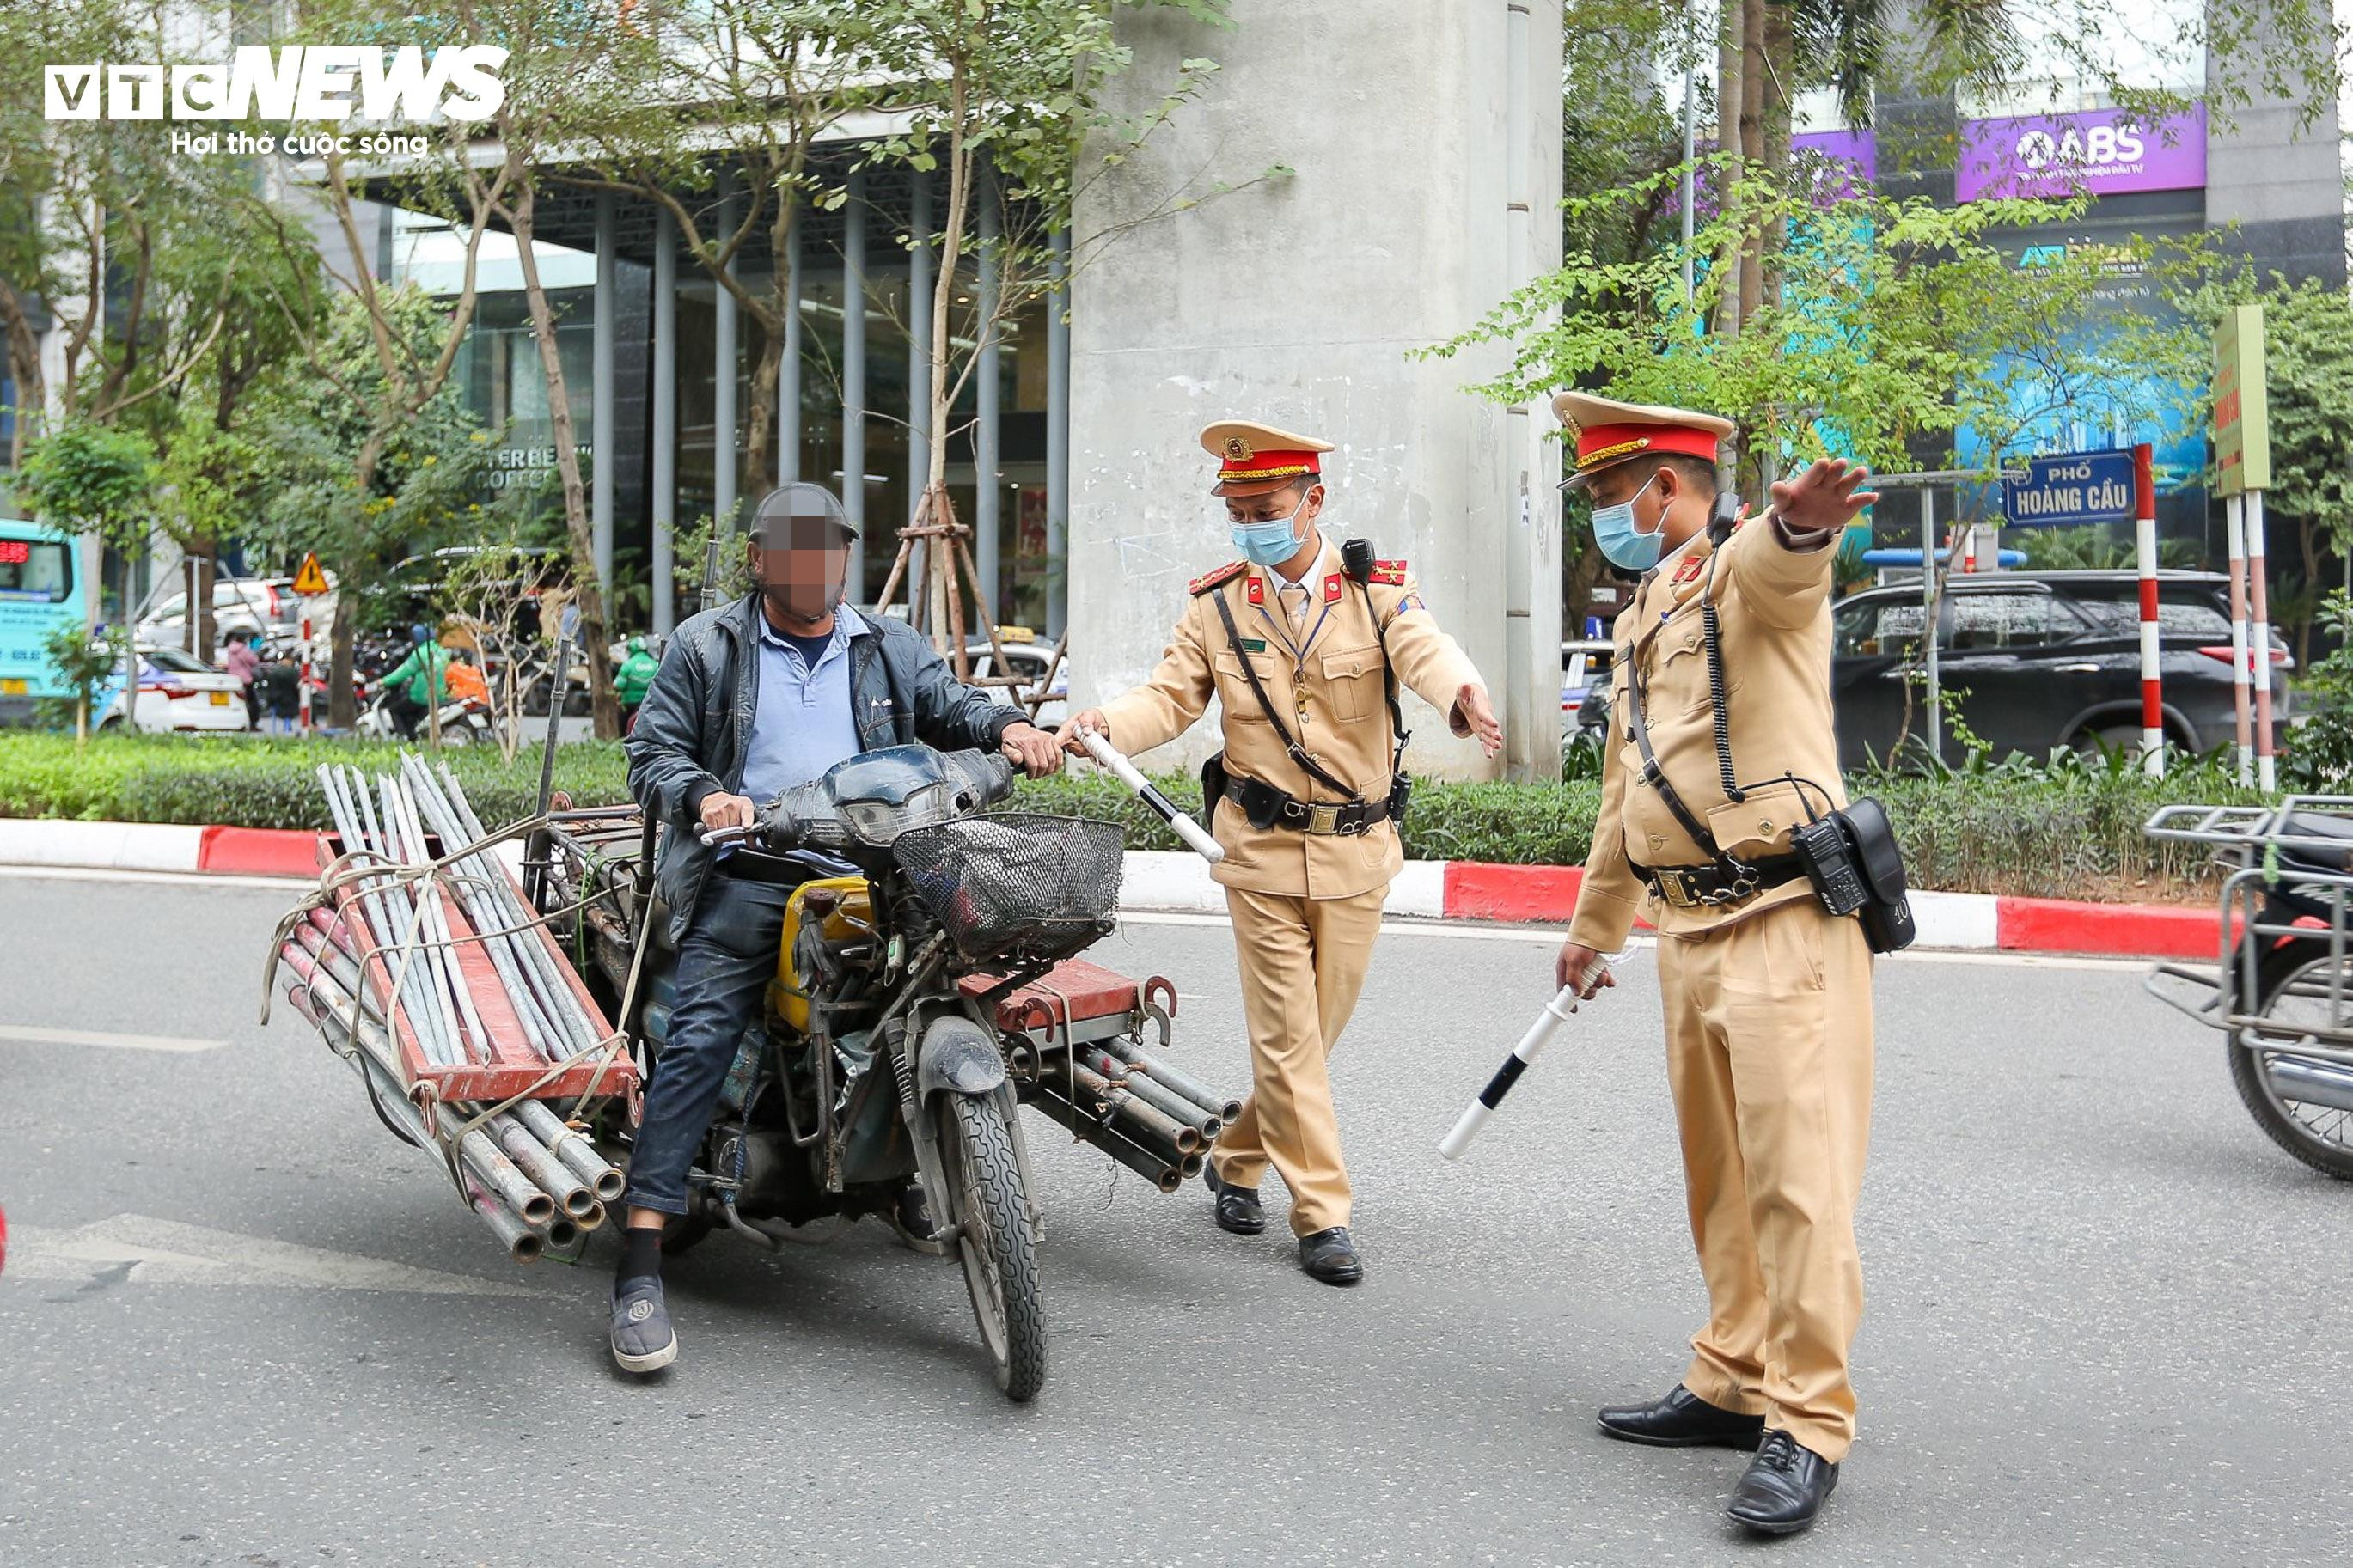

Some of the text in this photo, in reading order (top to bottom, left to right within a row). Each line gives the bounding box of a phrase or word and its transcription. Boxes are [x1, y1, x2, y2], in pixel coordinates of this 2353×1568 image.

[2059, 124, 2145, 165] ABS
[2048, 459, 2091, 481] PHỐ
[2016, 478, 2127, 515] HOÀNG CẦU
